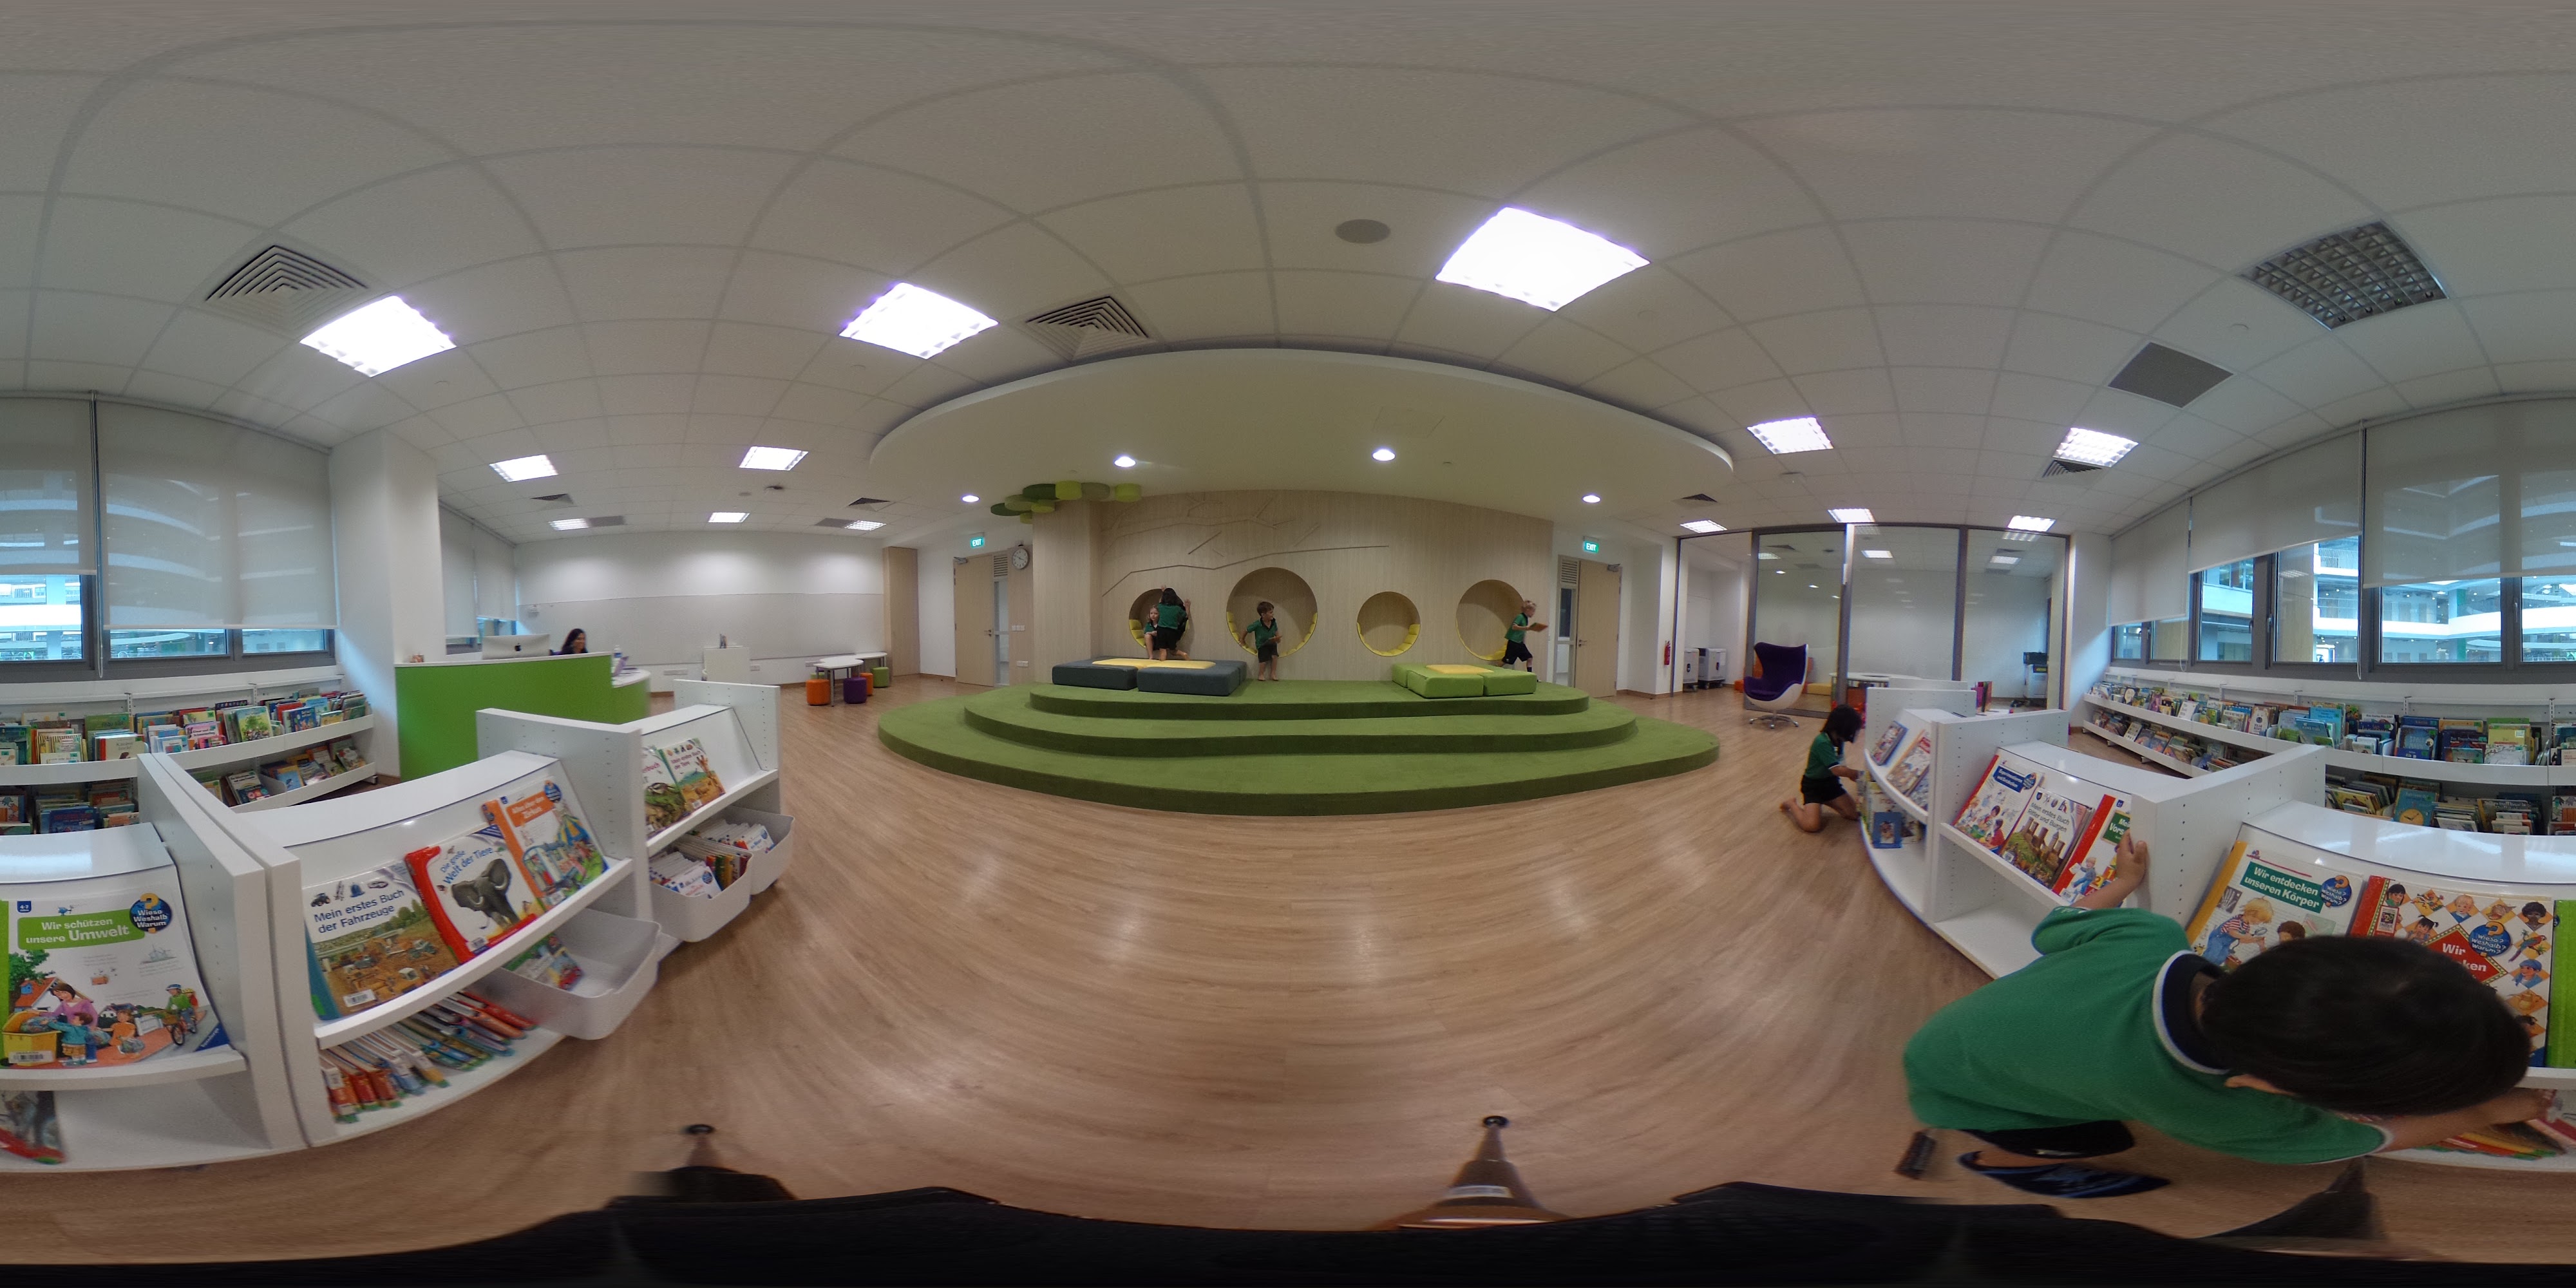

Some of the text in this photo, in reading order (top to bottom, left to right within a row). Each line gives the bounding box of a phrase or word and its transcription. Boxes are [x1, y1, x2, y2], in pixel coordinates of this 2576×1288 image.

[2027, 809, 2067, 833] Ritter und Burgen
[2031, 802, 2070, 826] Mein erstes Buch
[440, 863, 450, 873] Die
[442, 848, 493, 884] Welt der Tiere
[2253, 866, 2319, 896] Wir entdecken
[2244, 876, 2320, 909] unseren Körper
[314, 889, 405, 923] Mein erstes Buch
[41, 918, 113, 931] Wir schützen
[133, 914, 168, 922] Weshalb
[318, 904, 395, 934] der Fahrzeuge
[26, 925, 129, 943] unsere Umwelt
[2477, 933, 2505, 943] Wieso?
[2442, 943, 2467, 956] Wir
[2471, 938, 2507, 951] Weshalb?
[2471, 943, 2502, 954] Warum?
